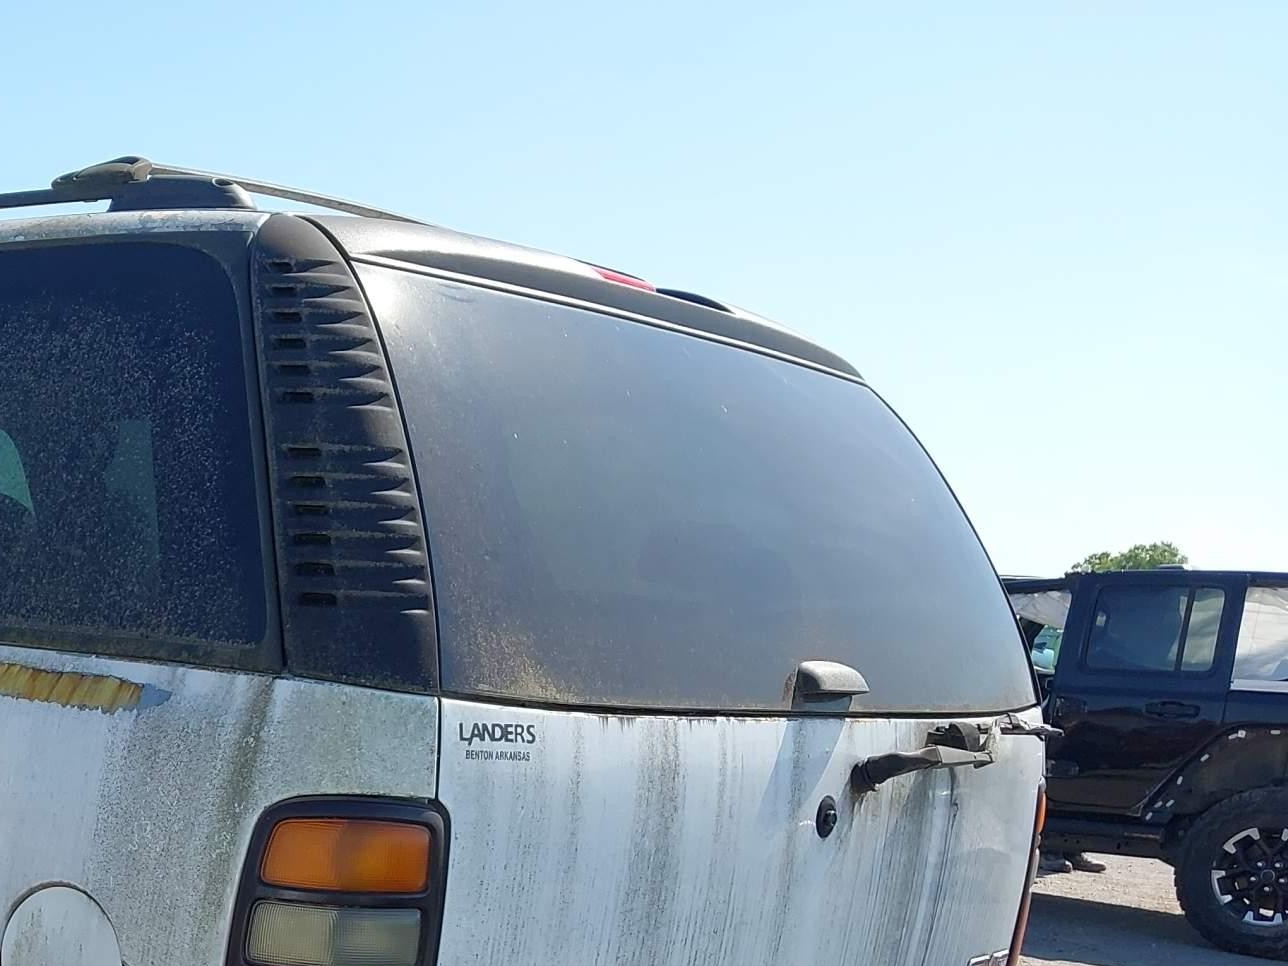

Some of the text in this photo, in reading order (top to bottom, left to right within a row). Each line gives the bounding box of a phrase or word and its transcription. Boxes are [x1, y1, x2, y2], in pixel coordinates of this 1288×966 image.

[459, 722, 536, 745] LANDERS
[465, 749, 531, 762] BENTON ARKANSAS
